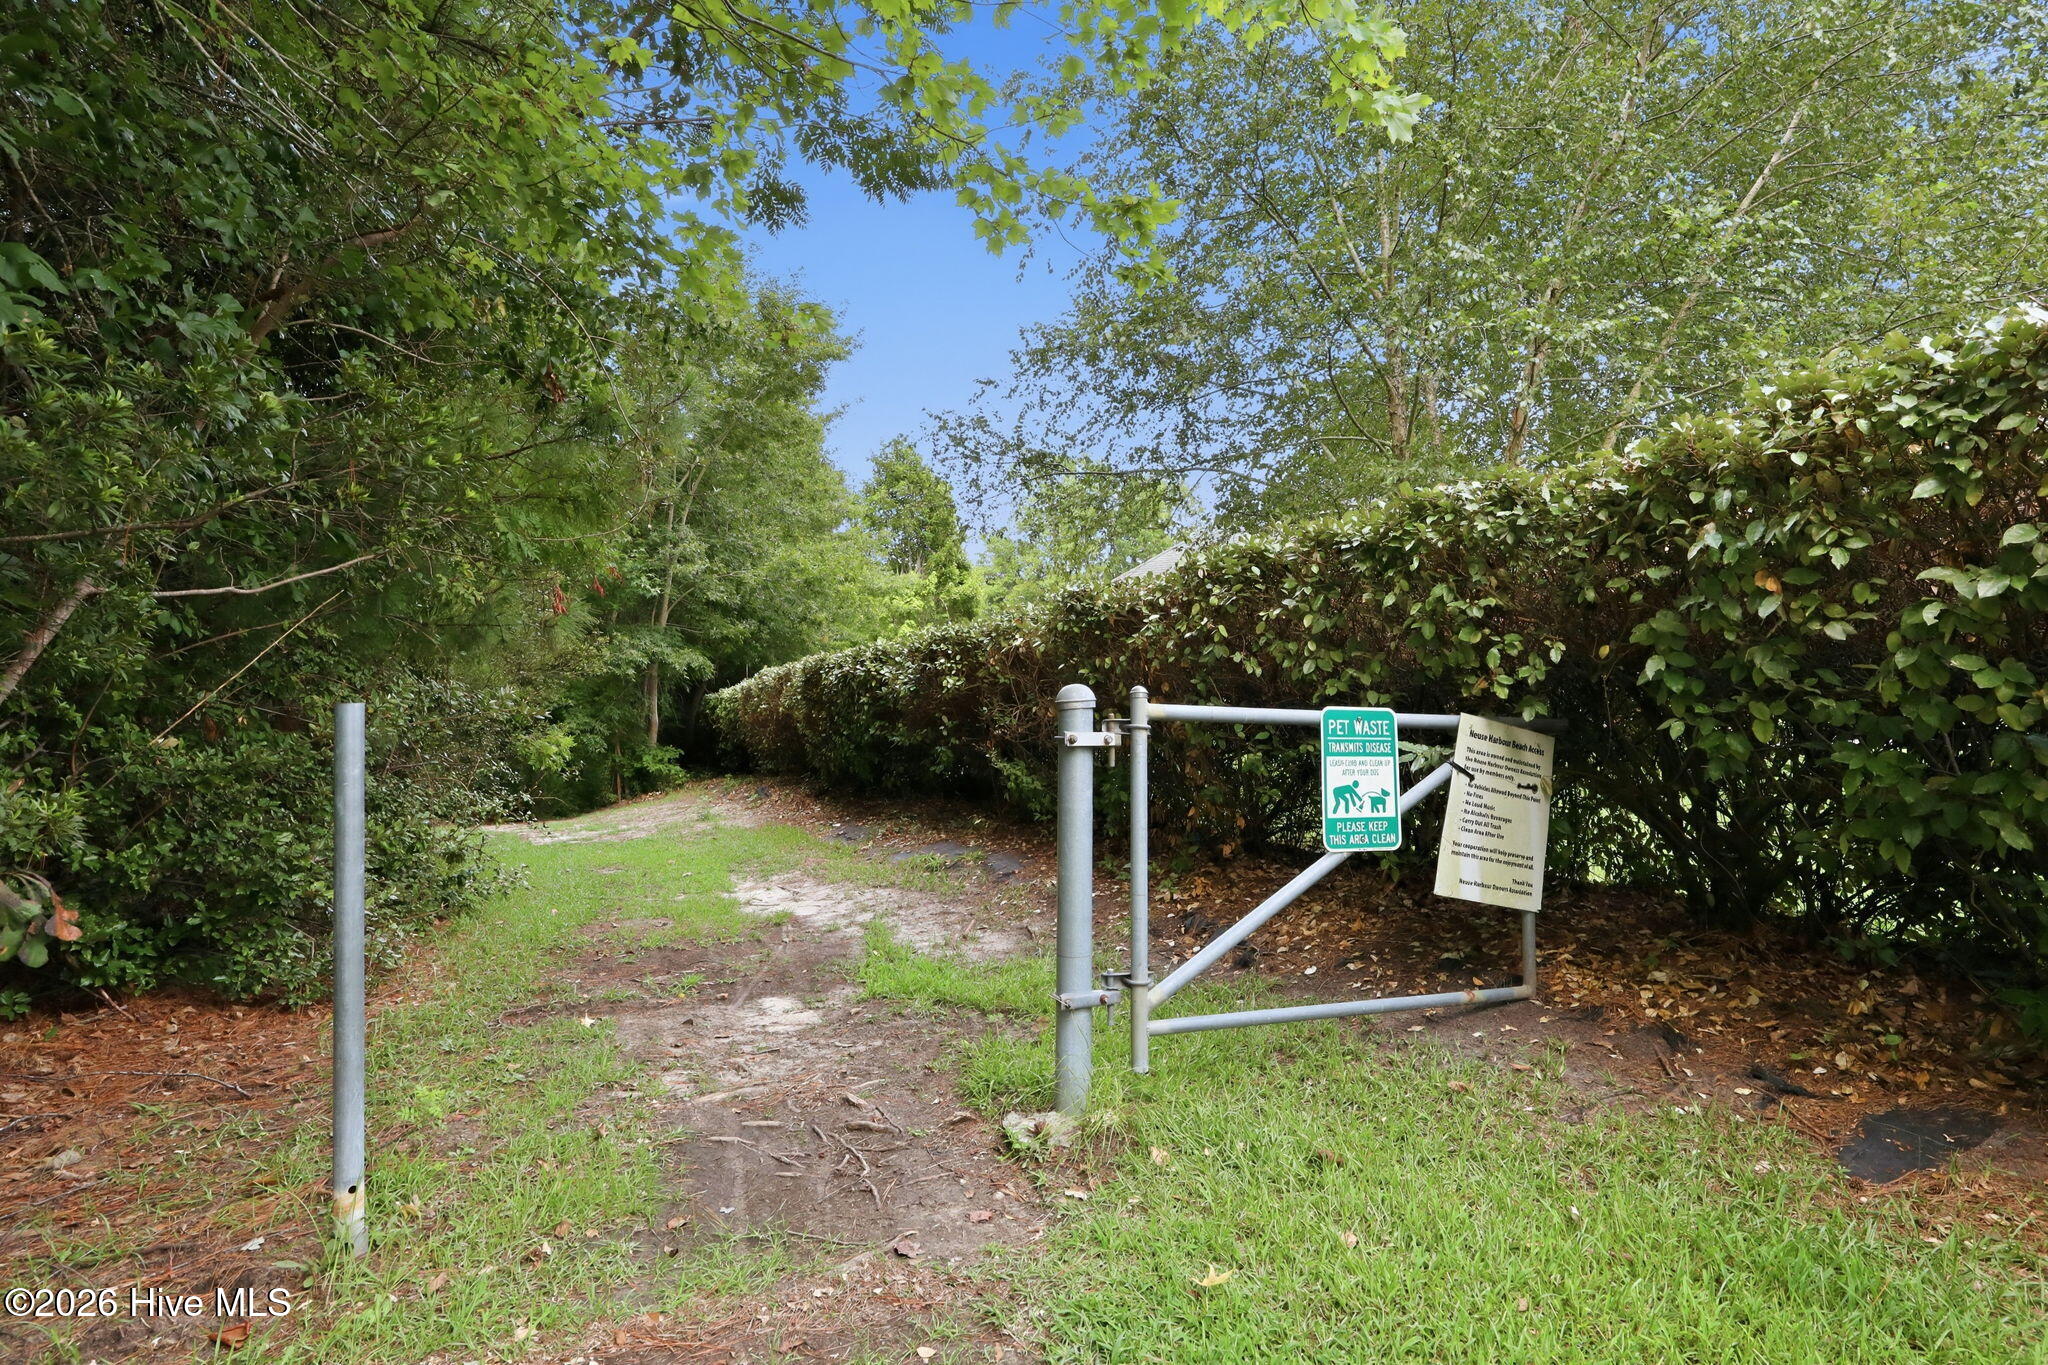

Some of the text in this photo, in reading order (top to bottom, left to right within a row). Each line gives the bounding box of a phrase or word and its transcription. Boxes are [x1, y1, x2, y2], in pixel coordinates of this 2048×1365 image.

[1328, 719, 1390, 735] PET WASTE
[1328, 742, 1391, 753] TRANSMITS DISEASE
[1469, 730, 1544, 756] Neuse Harbour Beach Access
[1474, 757, 1486, 765] Neuse
[1488, 760, 1504, 769] Harbour
[1505, 765, 1519, 773] Owners
[1520, 768, 1541, 778] Association
[1513, 758, 1535, 768] maintained
[1474, 783, 1490, 792] Vehicles
[1491, 788, 1507, 796] Allowed
[1507, 791, 1522, 799] Beyond
[1462, 817, 1474, 826] Carry
[1490, 814, 1512, 824] Beverages
[1336, 821, 1388, 832] PLEASE KEEP
[1329, 833, 1396, 845] THIS AREA CLEAN
[1462, 843, 1489, 852] cooperation
[1451, 850, 1470, 858] maintain
[1503, 860, 1524, 868] enjoyment
[1474, 880, 1492, 889] Harbour
[1509, 887, 1533, 896] Association
